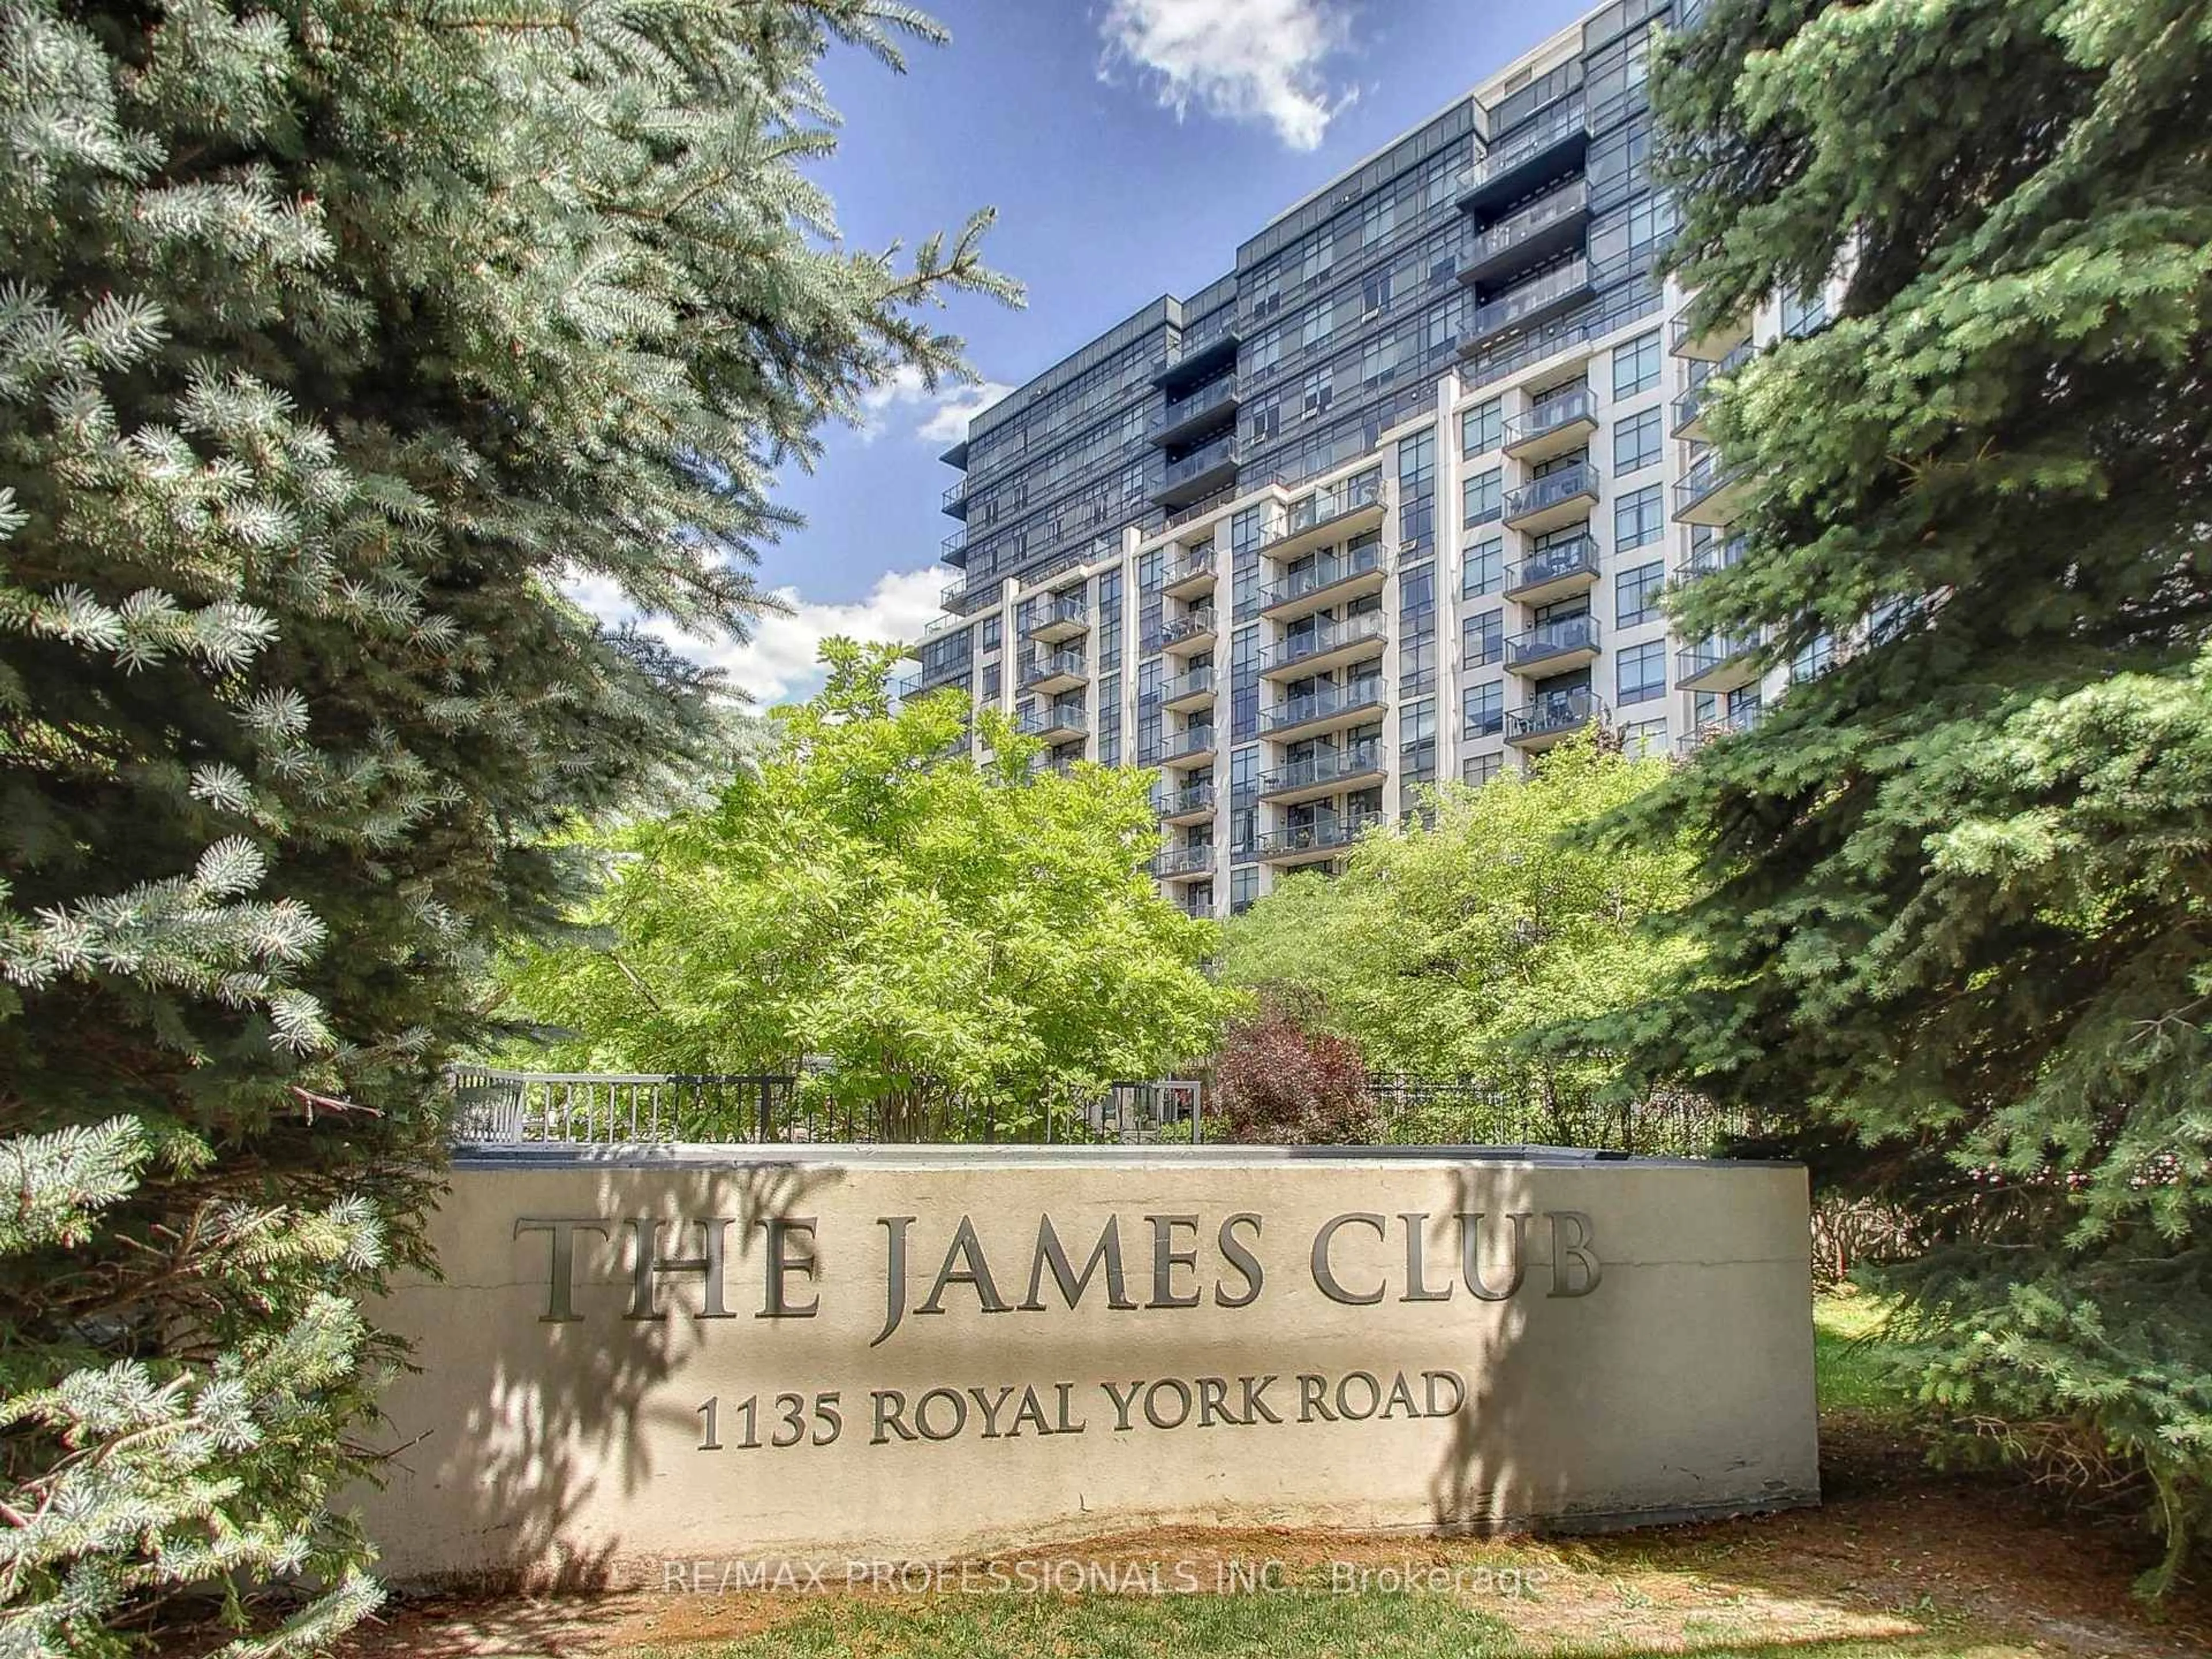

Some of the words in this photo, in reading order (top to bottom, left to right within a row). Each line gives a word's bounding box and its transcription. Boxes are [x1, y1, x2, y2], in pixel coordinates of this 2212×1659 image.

[514, 1215, 820, 1323] THE
[870, 1212, 1264, 1348] JAMES
[1310, 1210, 1603, 1305] CLUB
[696, 1391, 843, 1451] 1135
[870, 1381, 1088, 1446] ROYAL
[1100, 1374, 1283, 1431] YORK
[1296, 1369, 1466, 1423] ROAD
